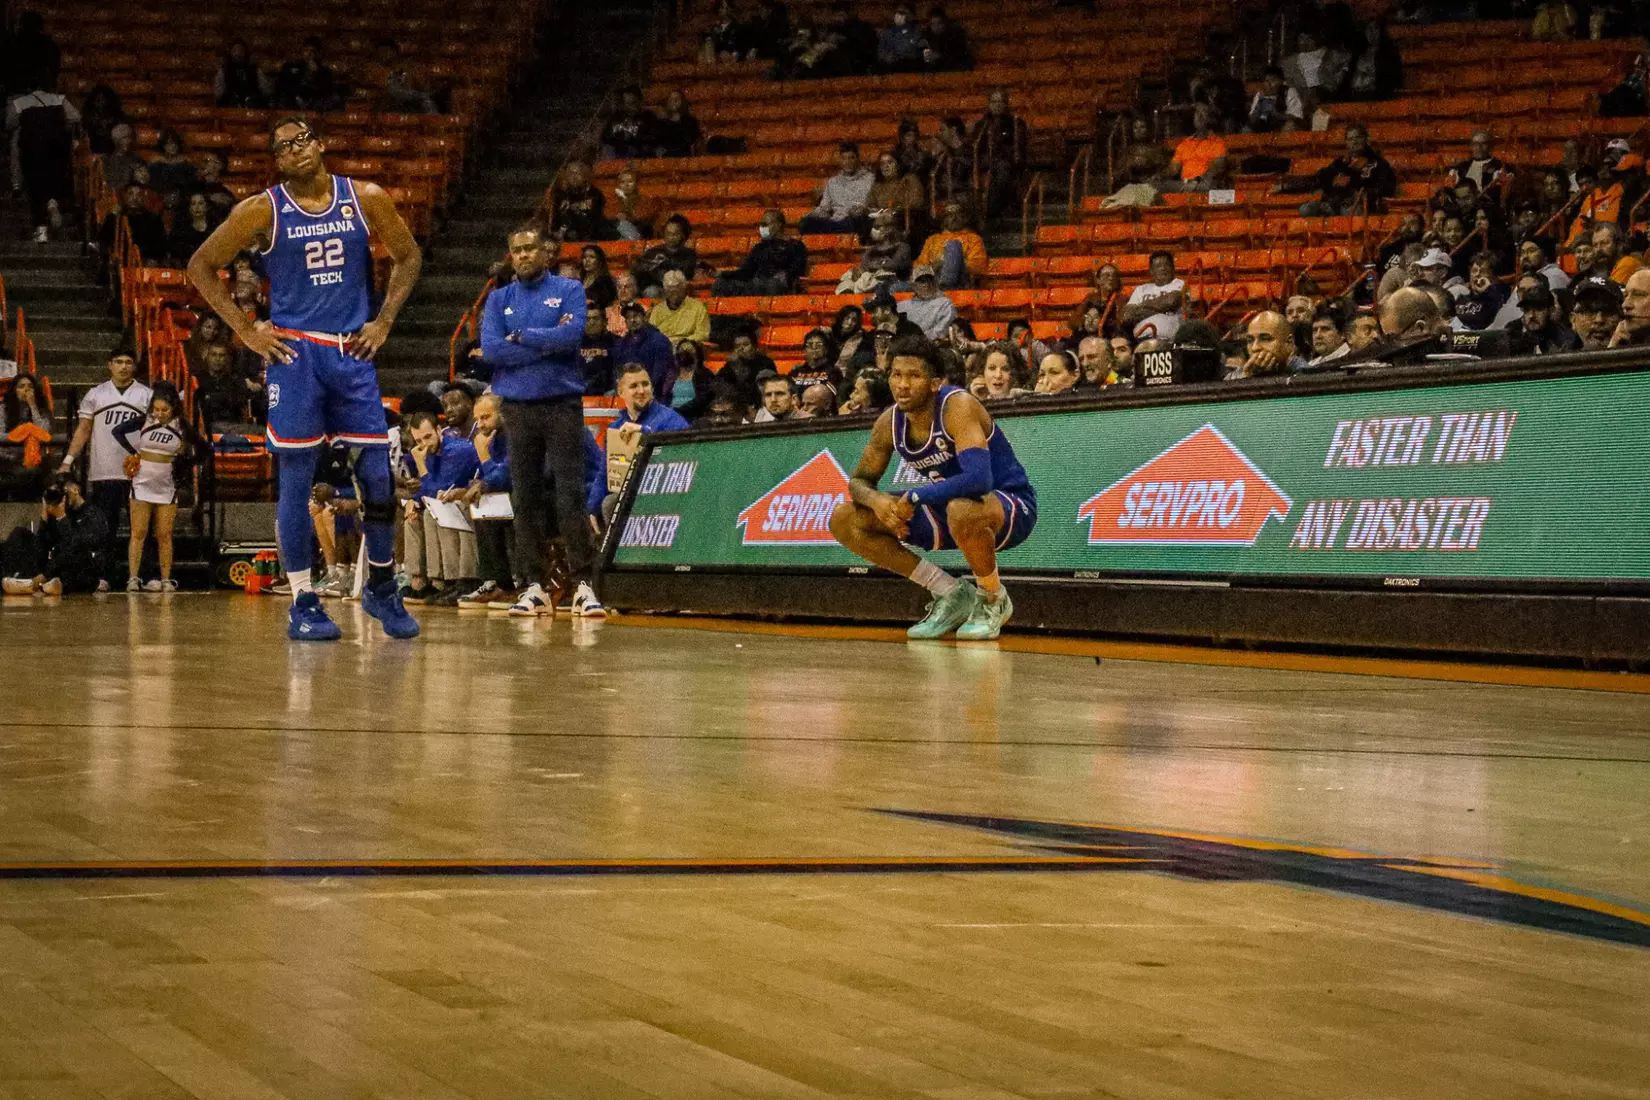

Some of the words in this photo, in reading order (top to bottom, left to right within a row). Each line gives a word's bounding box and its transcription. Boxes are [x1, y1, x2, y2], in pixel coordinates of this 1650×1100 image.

[286, 220, 355, 239] LOUISIANA
[304, 238, 345, 270] 22
[309, 271, 343, 286] TECH
[1143, 351, 1172, 377] POSS
[149, 431, 173, 444] UTEP
[1323, 416, 1433, 468] FASTER
[1432, 410, 1518, 463] THAN
[660, 461, 698, 493] THAN
[1116, 479, 1245, 529] SERVPRO
[1288, 498, 1353, 550] ANY
[1344, 497, 1492, 551] DISASTER
[1383, 577, 1420, 587] DAKTRONICS
